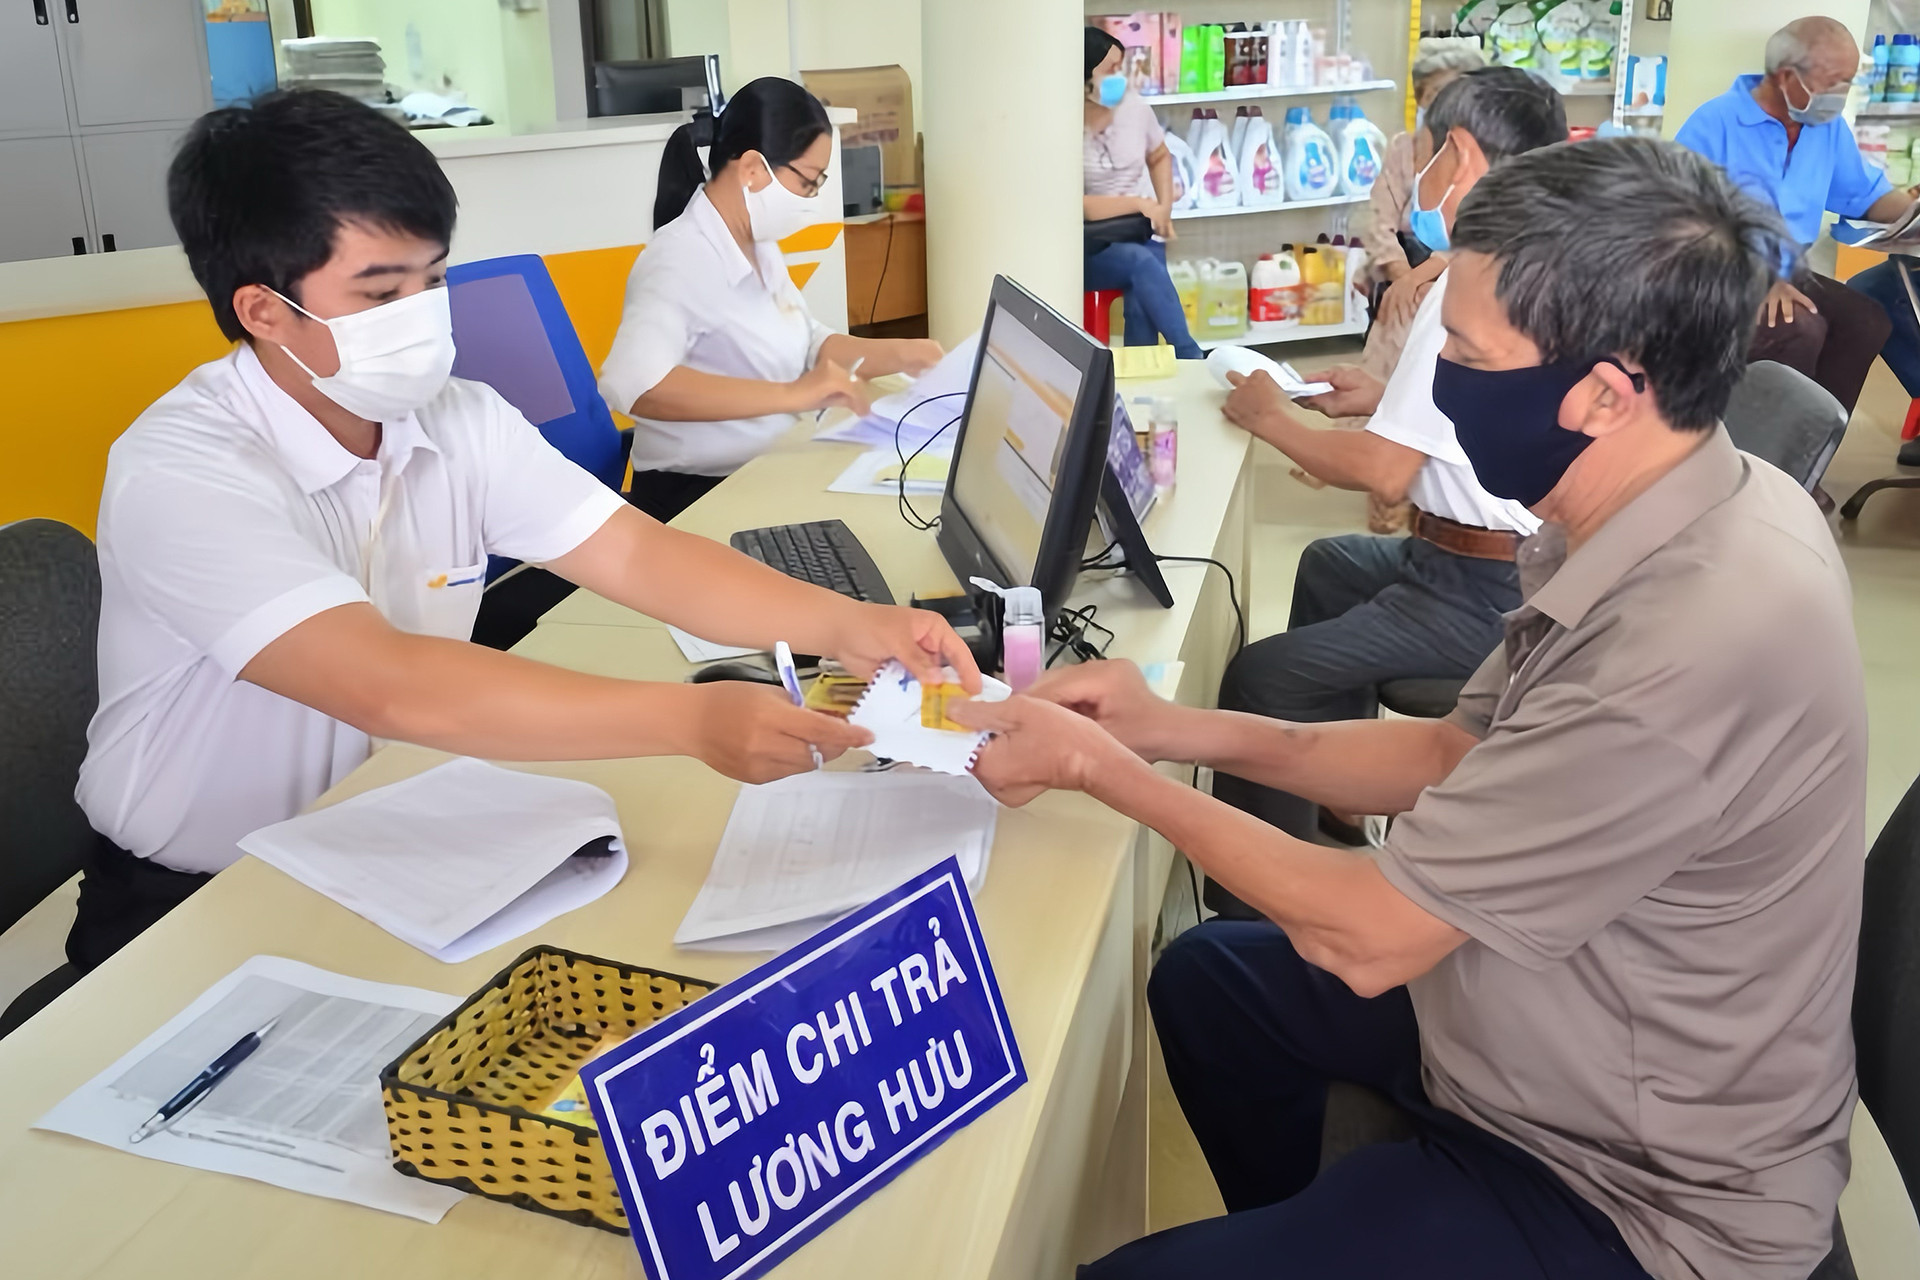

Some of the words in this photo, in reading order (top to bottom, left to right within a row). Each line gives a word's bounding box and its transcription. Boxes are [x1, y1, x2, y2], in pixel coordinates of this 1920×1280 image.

[640, 1043, 780, 1180] ĐIỂM
[786, 991, 873, 1084] CHI
[871, 917, 967, 1027] TRẢ
[696, 1101, 876, 1262] LƯƠNG
[878, 1029, 972, 1134] HƯU
